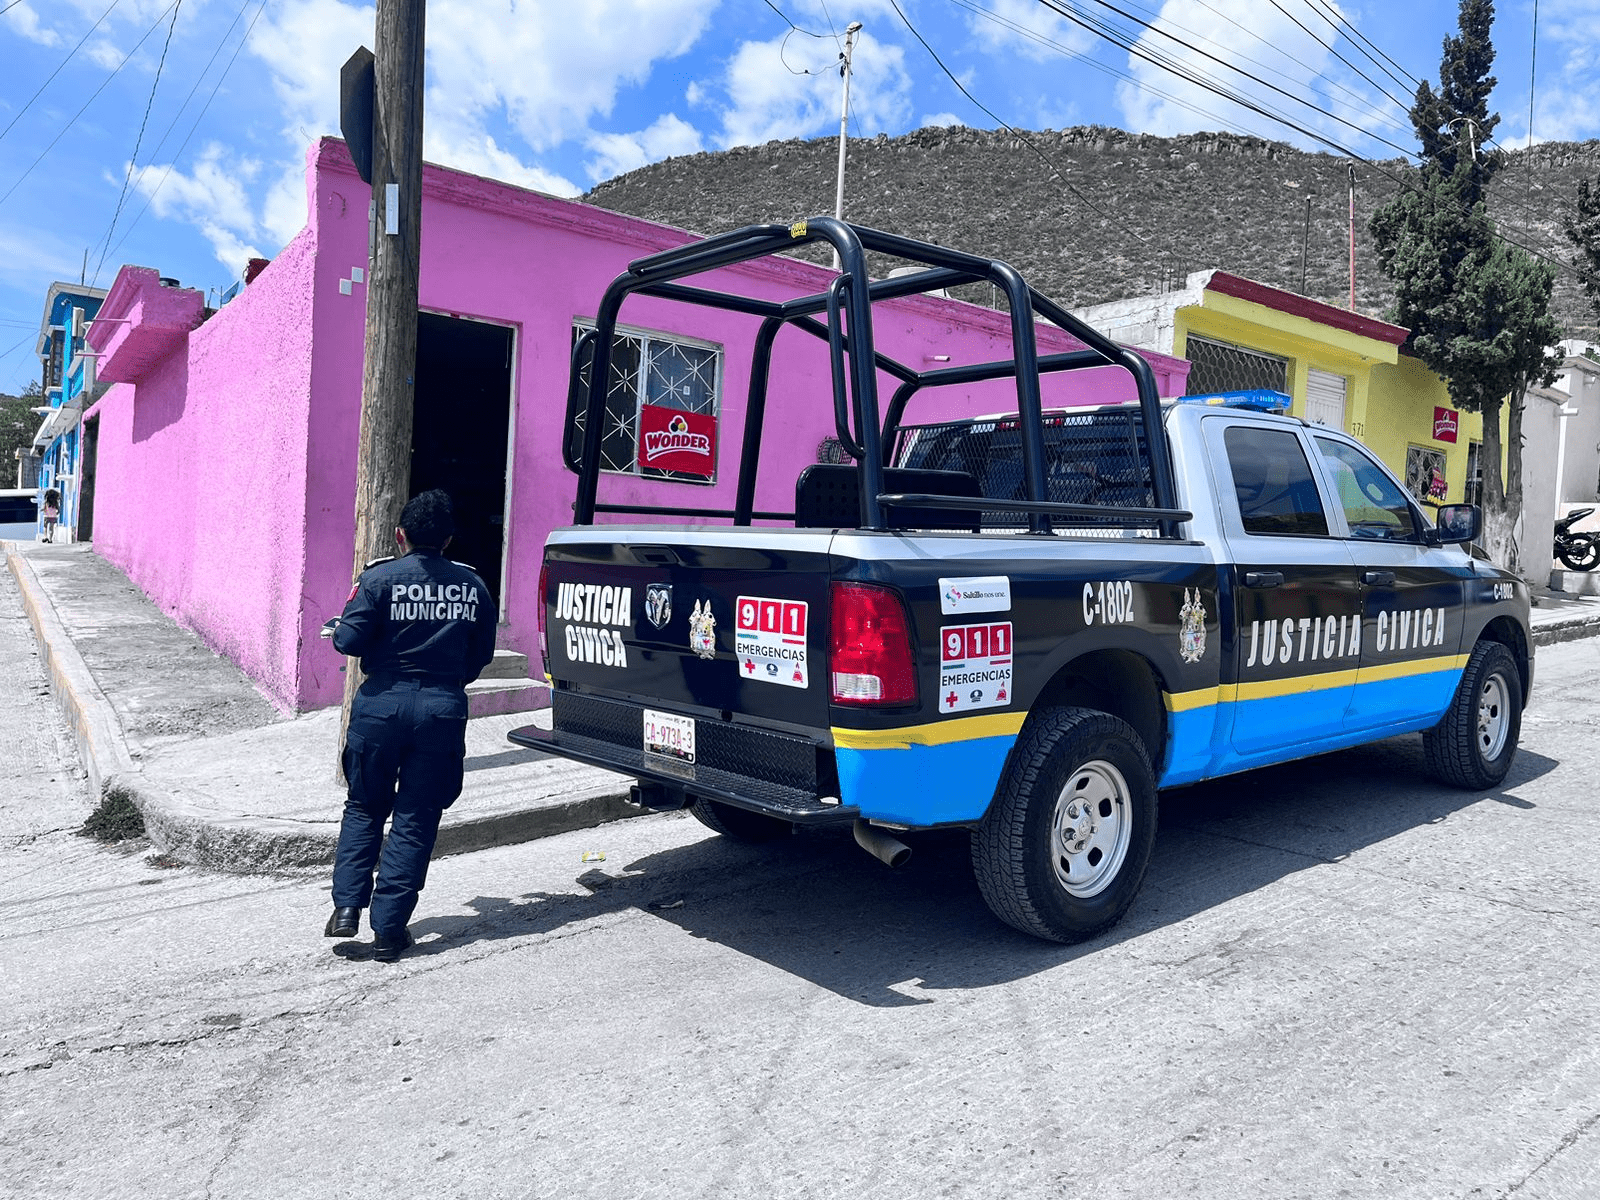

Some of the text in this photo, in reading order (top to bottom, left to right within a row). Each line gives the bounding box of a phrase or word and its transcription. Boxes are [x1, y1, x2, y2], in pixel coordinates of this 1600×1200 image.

[1352, 422, 1364, 437] 371
[646, 432, 708, 451] WONDER
[391, 583, 479, 605] POLICÍA
[555, 582, 632, 627] JUSTICIA
[962, 591, 983, 599] Saltillo
[1083, 580, 1134, 626] C-1802
[390, 602, 477, 622] MUNICIPAL
[742, 603, 799, 633] 911
[1376, 607, 1445, 652] CIVICA
[737, 643, 805, 661] EMERGENCIAS
[947, 629, 1004, 657] 911
[1246, 614, 1361, 668] JUSTICIA
[942, 669, 1011, 686] EMERGENCIAS
